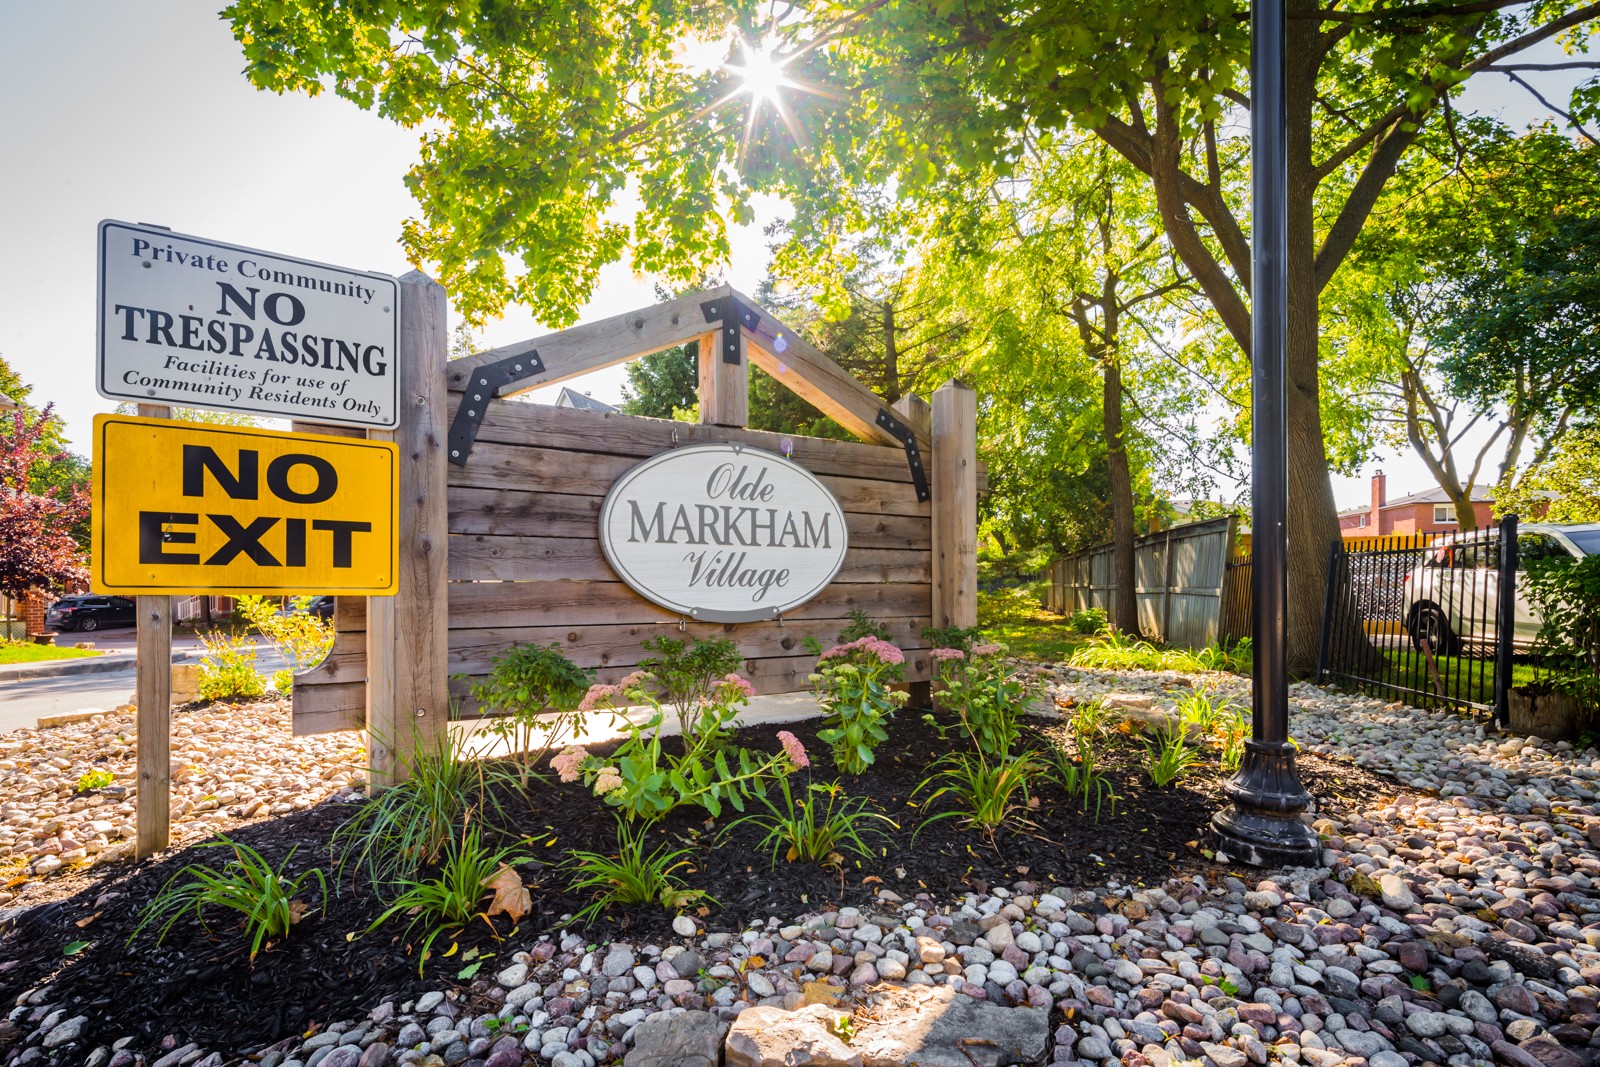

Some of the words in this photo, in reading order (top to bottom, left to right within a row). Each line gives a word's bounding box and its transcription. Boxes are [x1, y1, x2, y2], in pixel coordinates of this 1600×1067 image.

[131, 237, 229, 273] Private
[237, 259, 376, 305] Community
[216, 281, 306, 327] NO
[114, 304, 388, 377] TRESPASSING
[122, 370, 242, 402] Community
[248, 385, 337, 410] Residents
[342, 397, 381, 418] Only
[163, 355, 257, 381] Facilities
[259, 368, 291, 387] for
[296, 376, 325, 390] use
[330, 378, 351, 396] of
[182, 443, 339, 504] NO
[706, 462, 775, 502] Olde
[139, 511, 372, 569] EXIT
[627, 499, 832, 549] MARKHAM
[682, 550, 790, 603] Village
